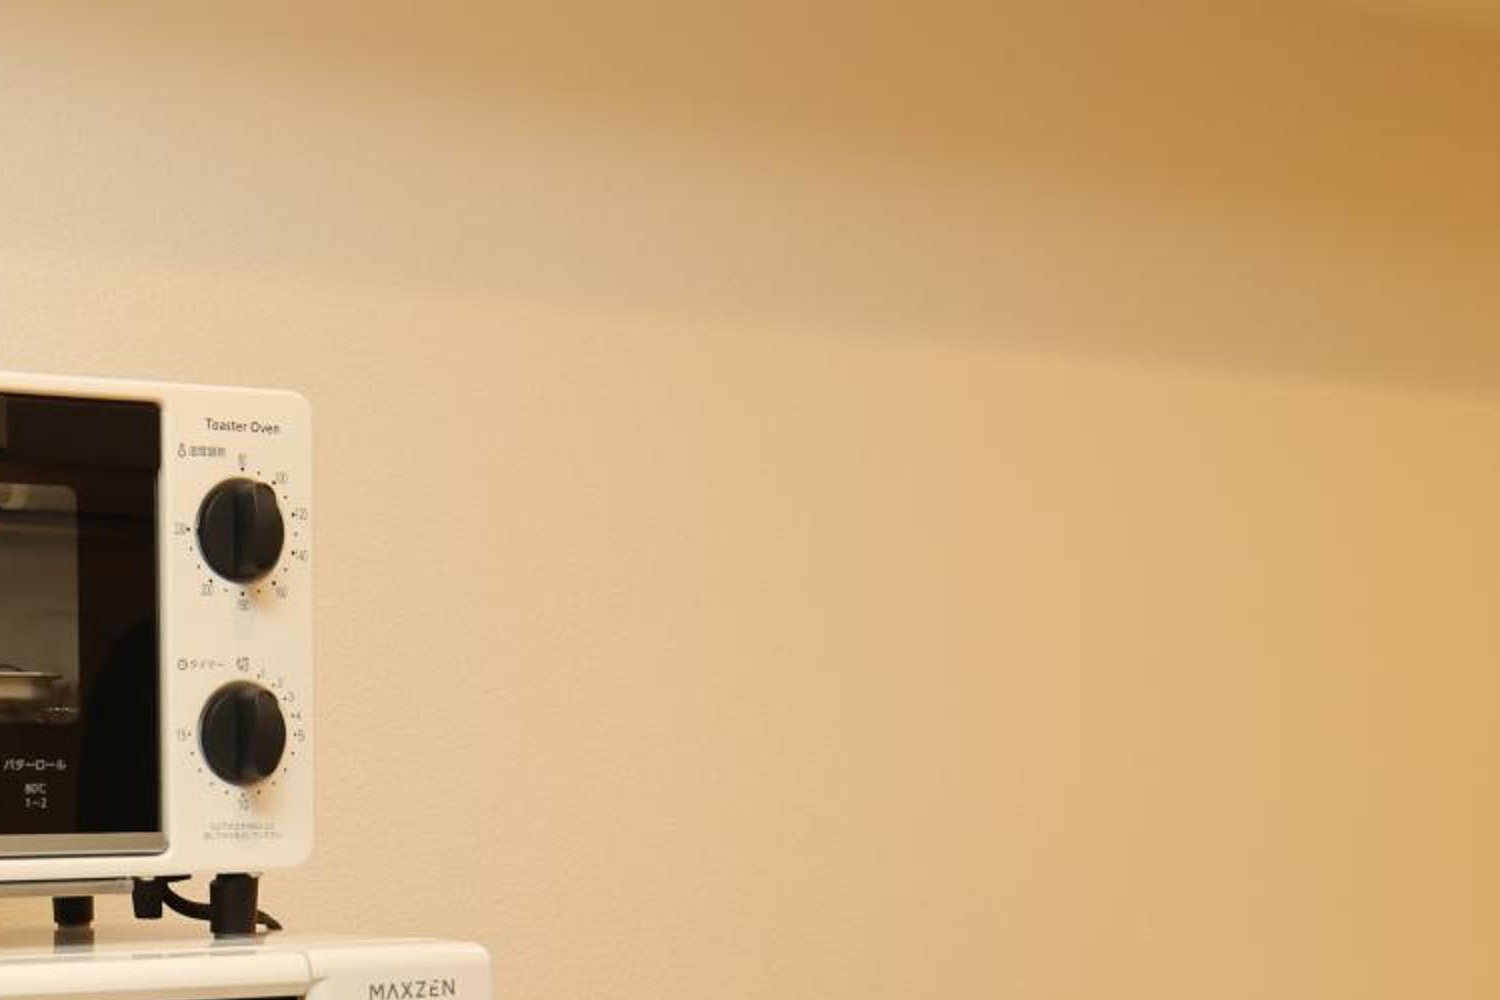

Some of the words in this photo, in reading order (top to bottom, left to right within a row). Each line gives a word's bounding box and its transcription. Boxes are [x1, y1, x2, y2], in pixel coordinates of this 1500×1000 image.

[206, 418, 247, 432] Toaster
[250, 421, 280, 434] Oven
[3, 759, 67, 771] バターロール
[368, 979, 456, 1000] MAXZEN
